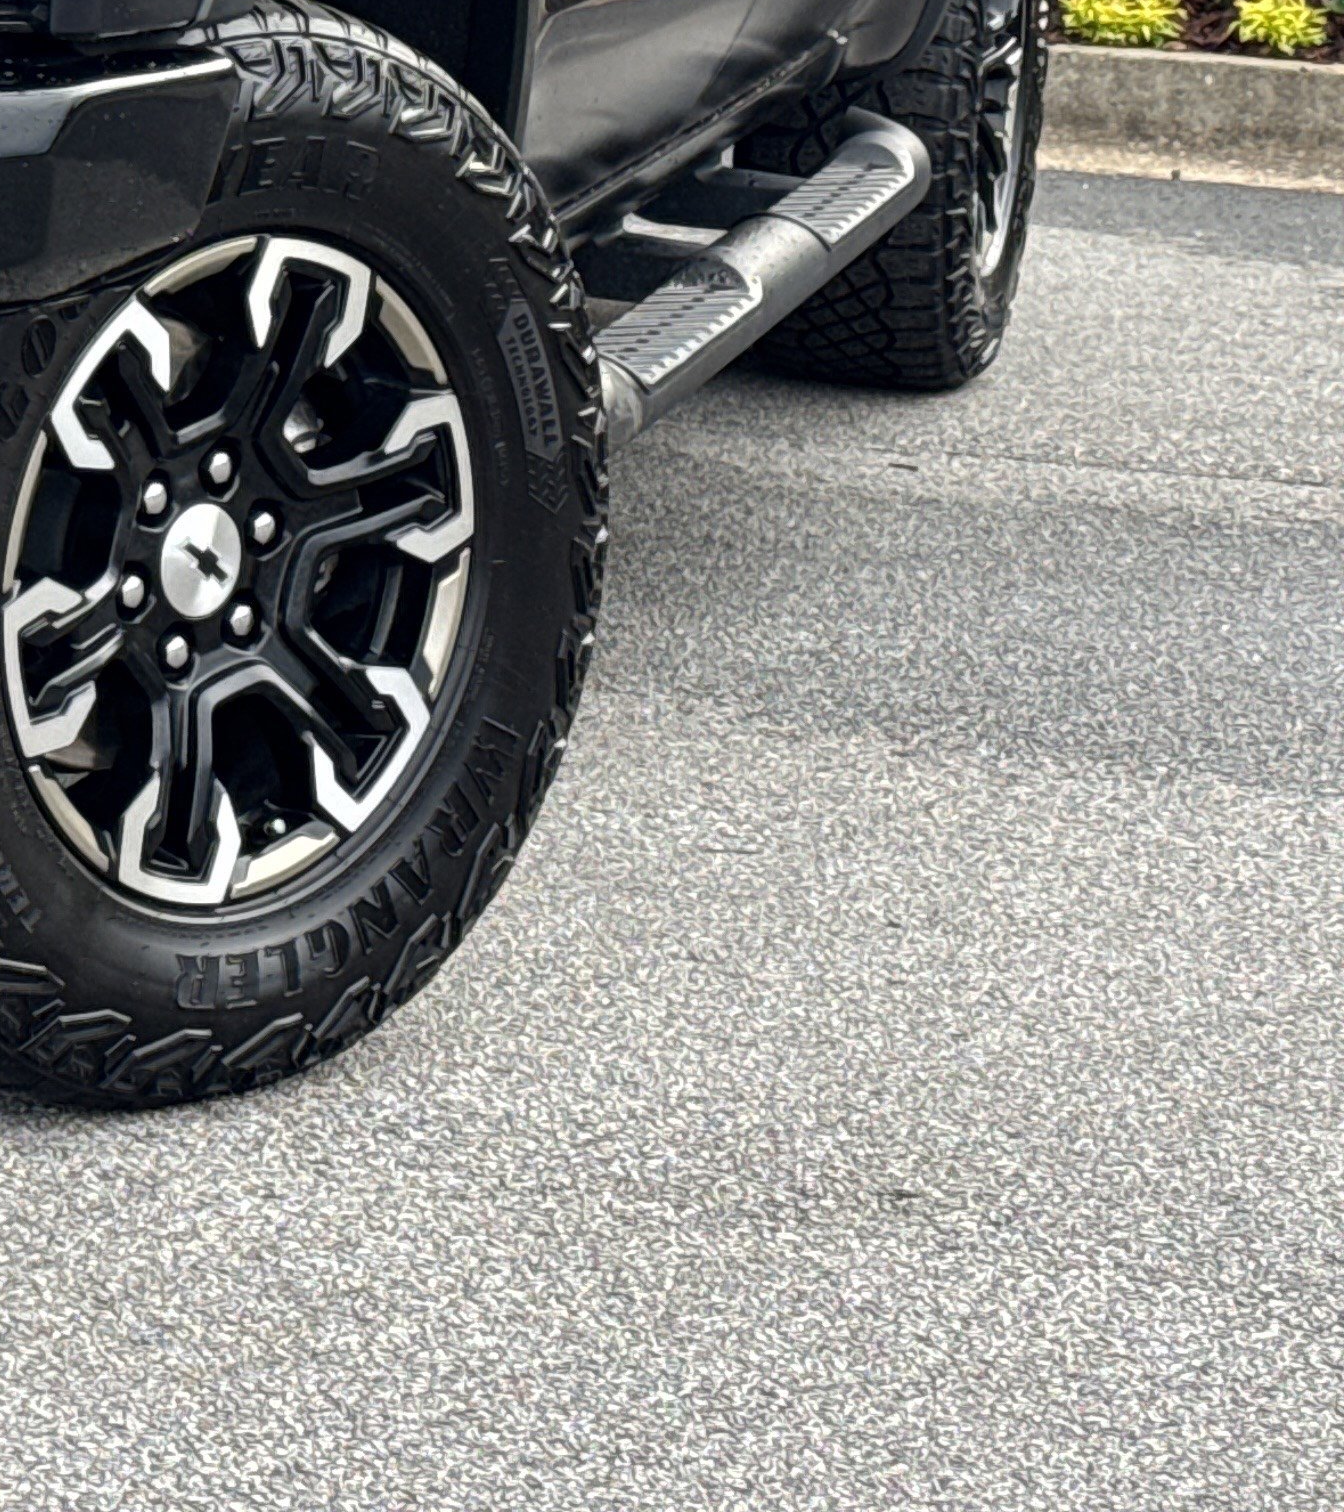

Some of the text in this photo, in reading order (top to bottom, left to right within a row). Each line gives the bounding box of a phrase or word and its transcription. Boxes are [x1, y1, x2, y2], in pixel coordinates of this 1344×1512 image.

[504, 336, 538, 437] TECHNOLOGY
[513, 312, 559, 447] DURAWALL
[176, 716, 521, 1011] WRANGLER
